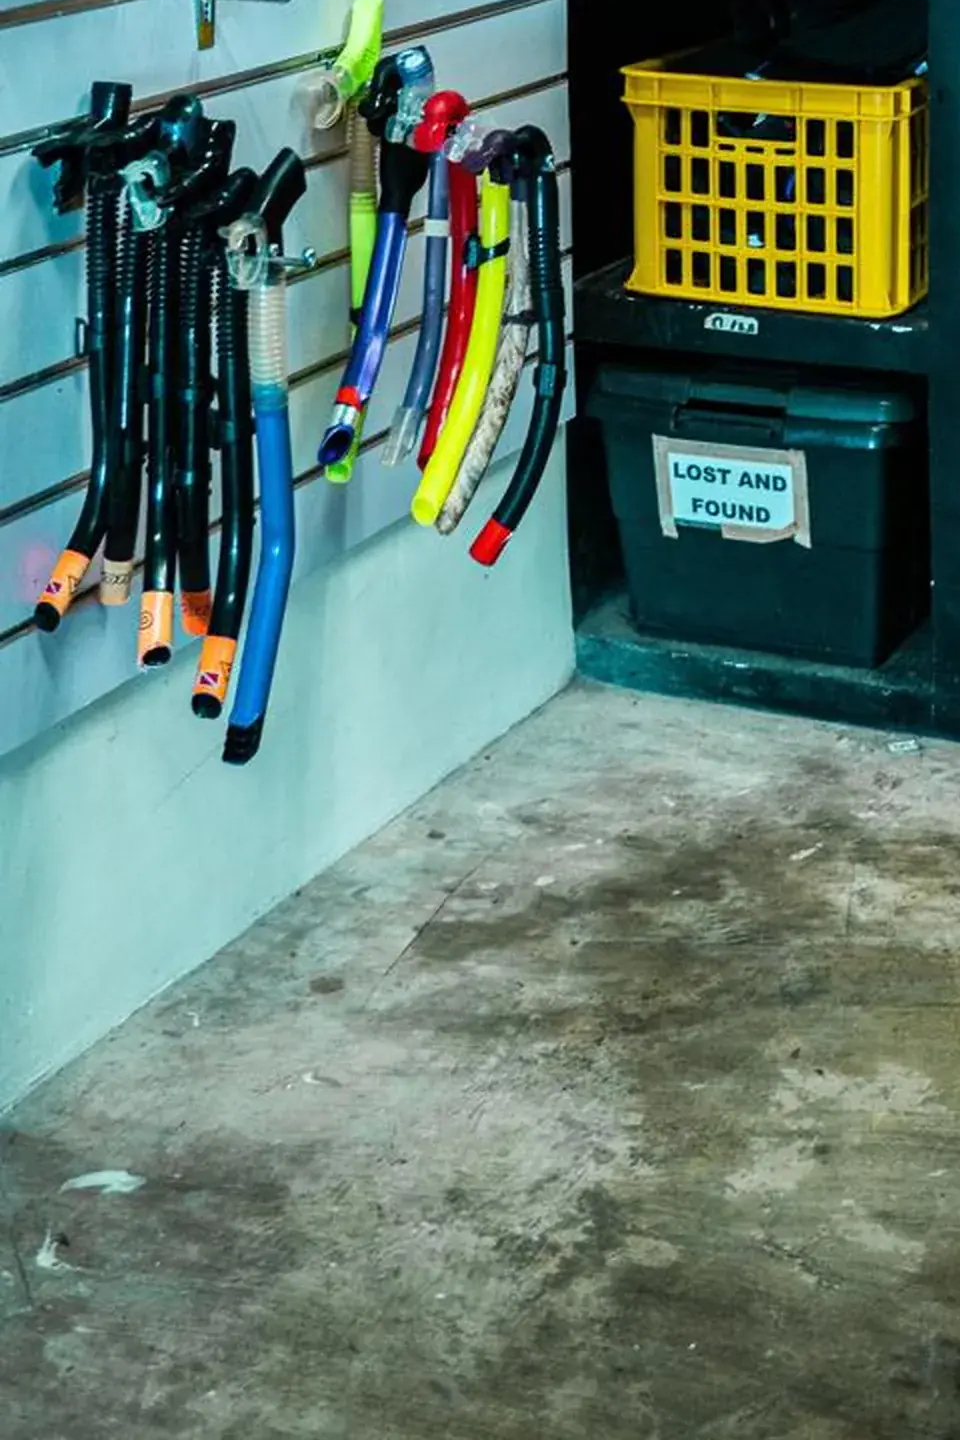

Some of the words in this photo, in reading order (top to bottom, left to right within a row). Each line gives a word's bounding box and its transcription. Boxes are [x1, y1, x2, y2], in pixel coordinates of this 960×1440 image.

[673, 462, 731, 485] LOST
[738, 471, 787, 492] AND
[691, 497, 770, 523] FOUND
